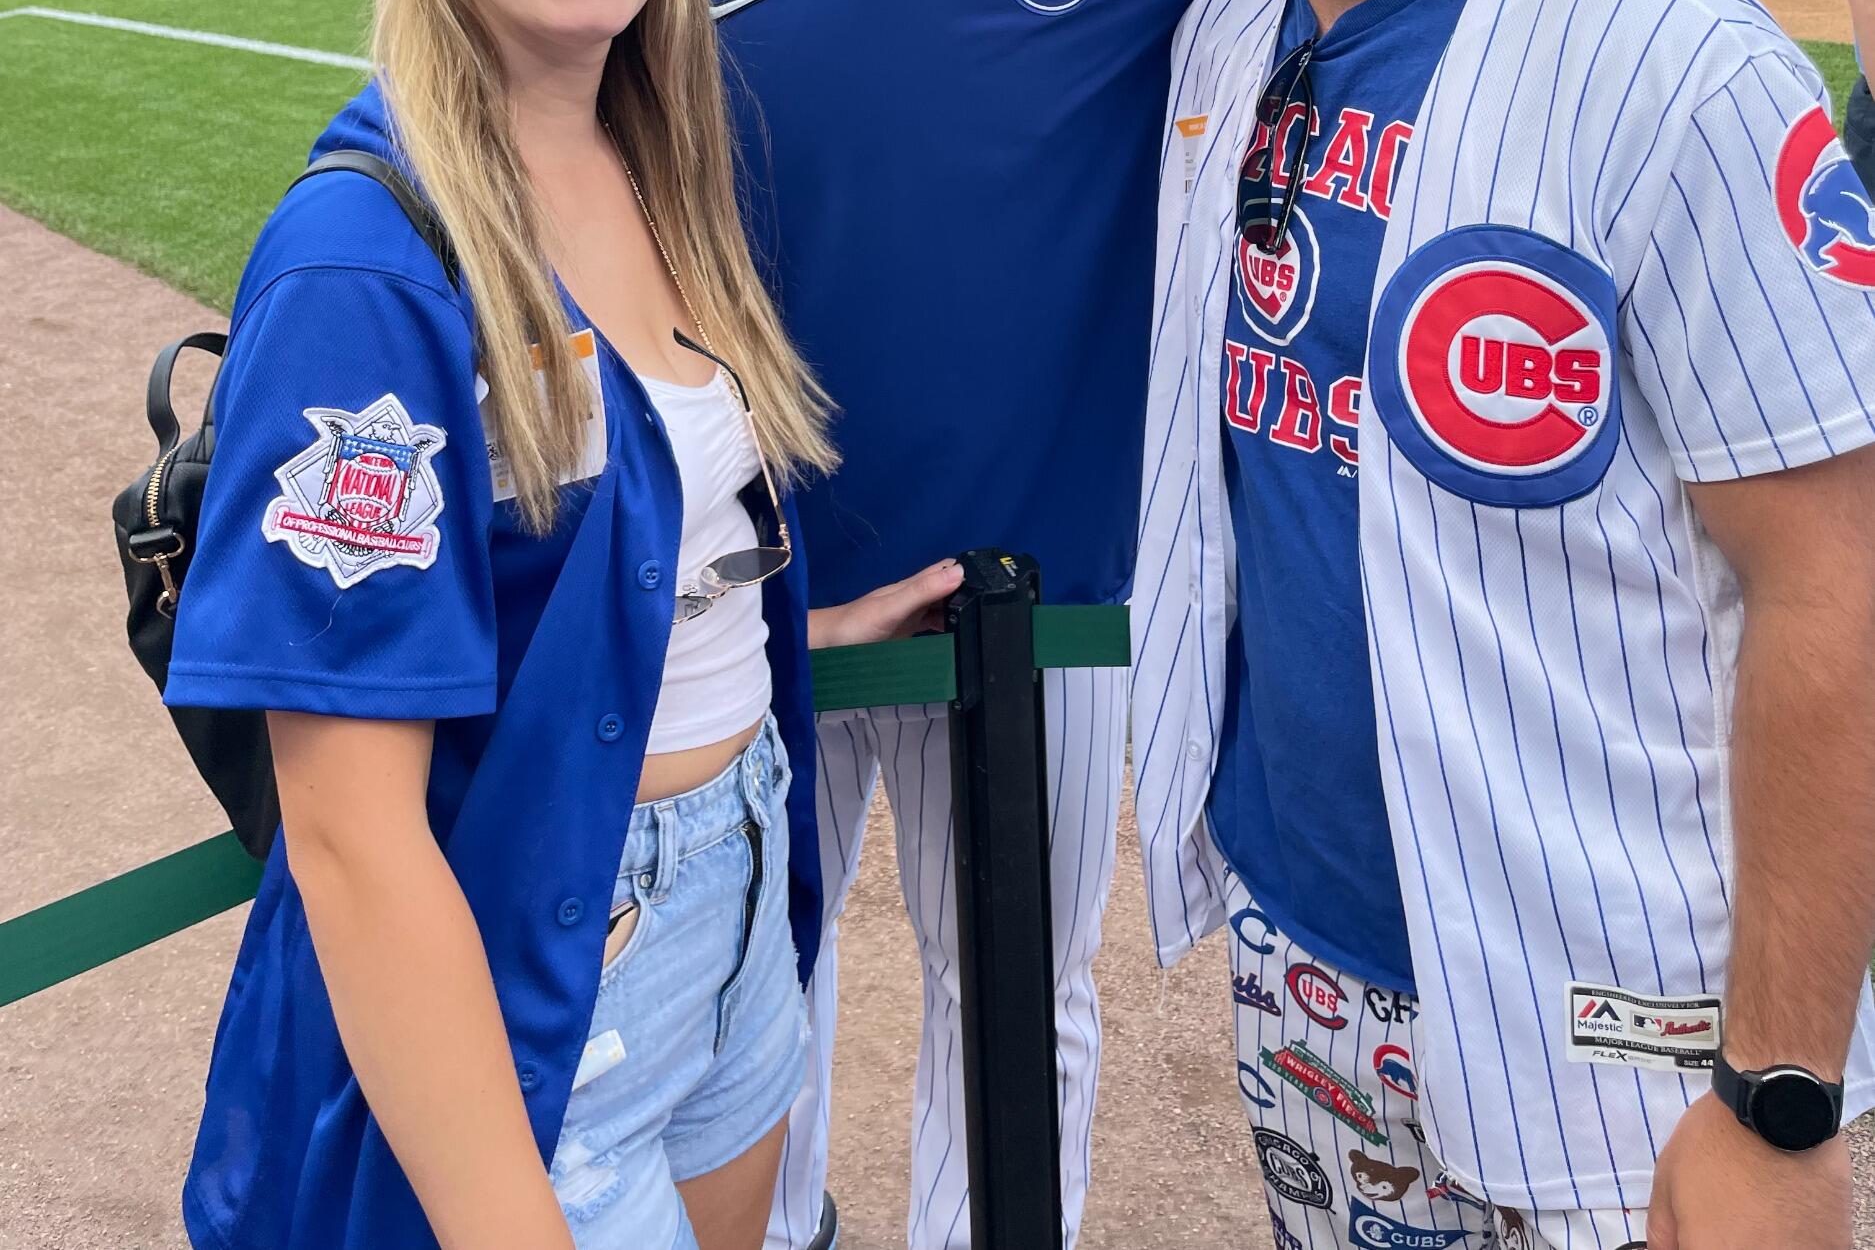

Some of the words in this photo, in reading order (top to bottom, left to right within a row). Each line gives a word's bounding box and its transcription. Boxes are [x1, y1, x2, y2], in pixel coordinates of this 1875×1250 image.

[1405, 268, 1601, 467] CUBS
[340, 463, 397, 506] NATIONAL
[345, 504, 383, 520] LEAGUE
[283, 516, 296, 528] OF
[295, 519, 359, 542] PROFESSIONAL
[1286, 962, 1349, 1031] CUBS
[1592, 990, 1637, 1005] ENGINEERED
[1637, 998, 1685, 1009] EXCLUSIVELY
[1577, 1018, 1623, 1033] Majestic
[1660, 1020, 1712, 1037] Authentic
[1594, 1036, 1624, 1047] MAJOR
[1625, 1039, 1659, 1052] LEAGUE
[1661, 1046, 1700, 1056] BASEBALL
[1684, 1059, 1699, 1067] SIZE
[1700, 1058, 1714, 1067] 44
[1286, 1054, 1336, 1092] WRIGLEY
[1336, 1092, 1368, 1124] FIELD
[1390, 1231, 1447, 1249] CUBS
